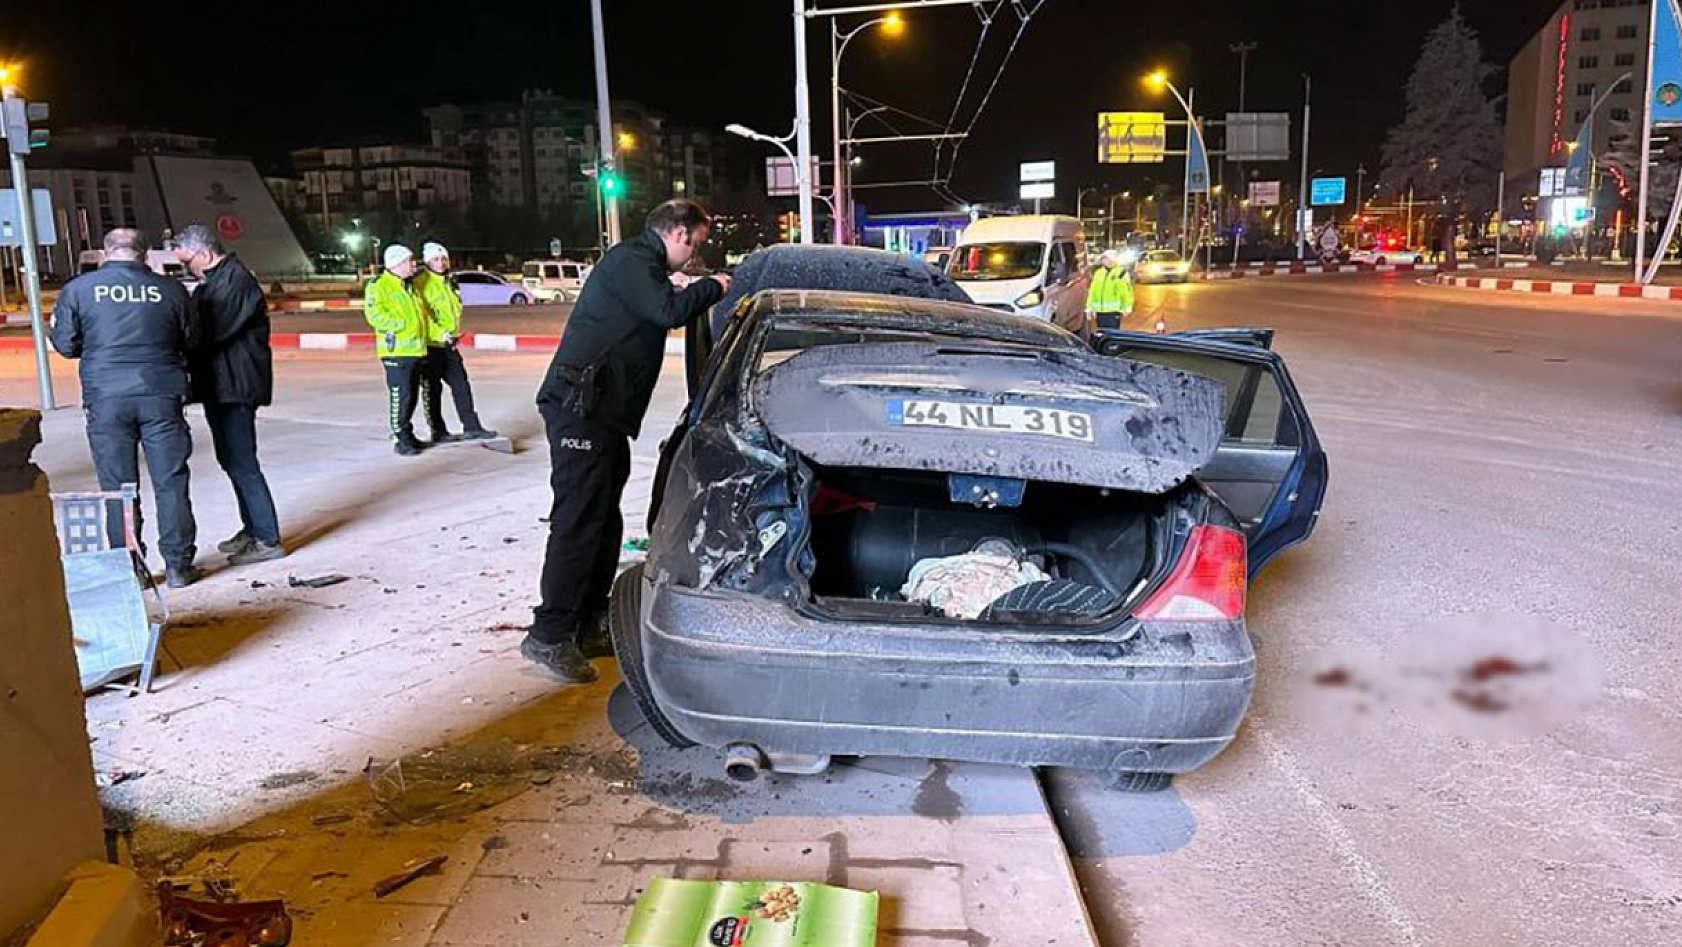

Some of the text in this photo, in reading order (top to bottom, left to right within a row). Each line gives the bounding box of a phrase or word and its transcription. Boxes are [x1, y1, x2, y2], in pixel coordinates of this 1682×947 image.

[905, 402, 1088, 438] 44 NL 319
